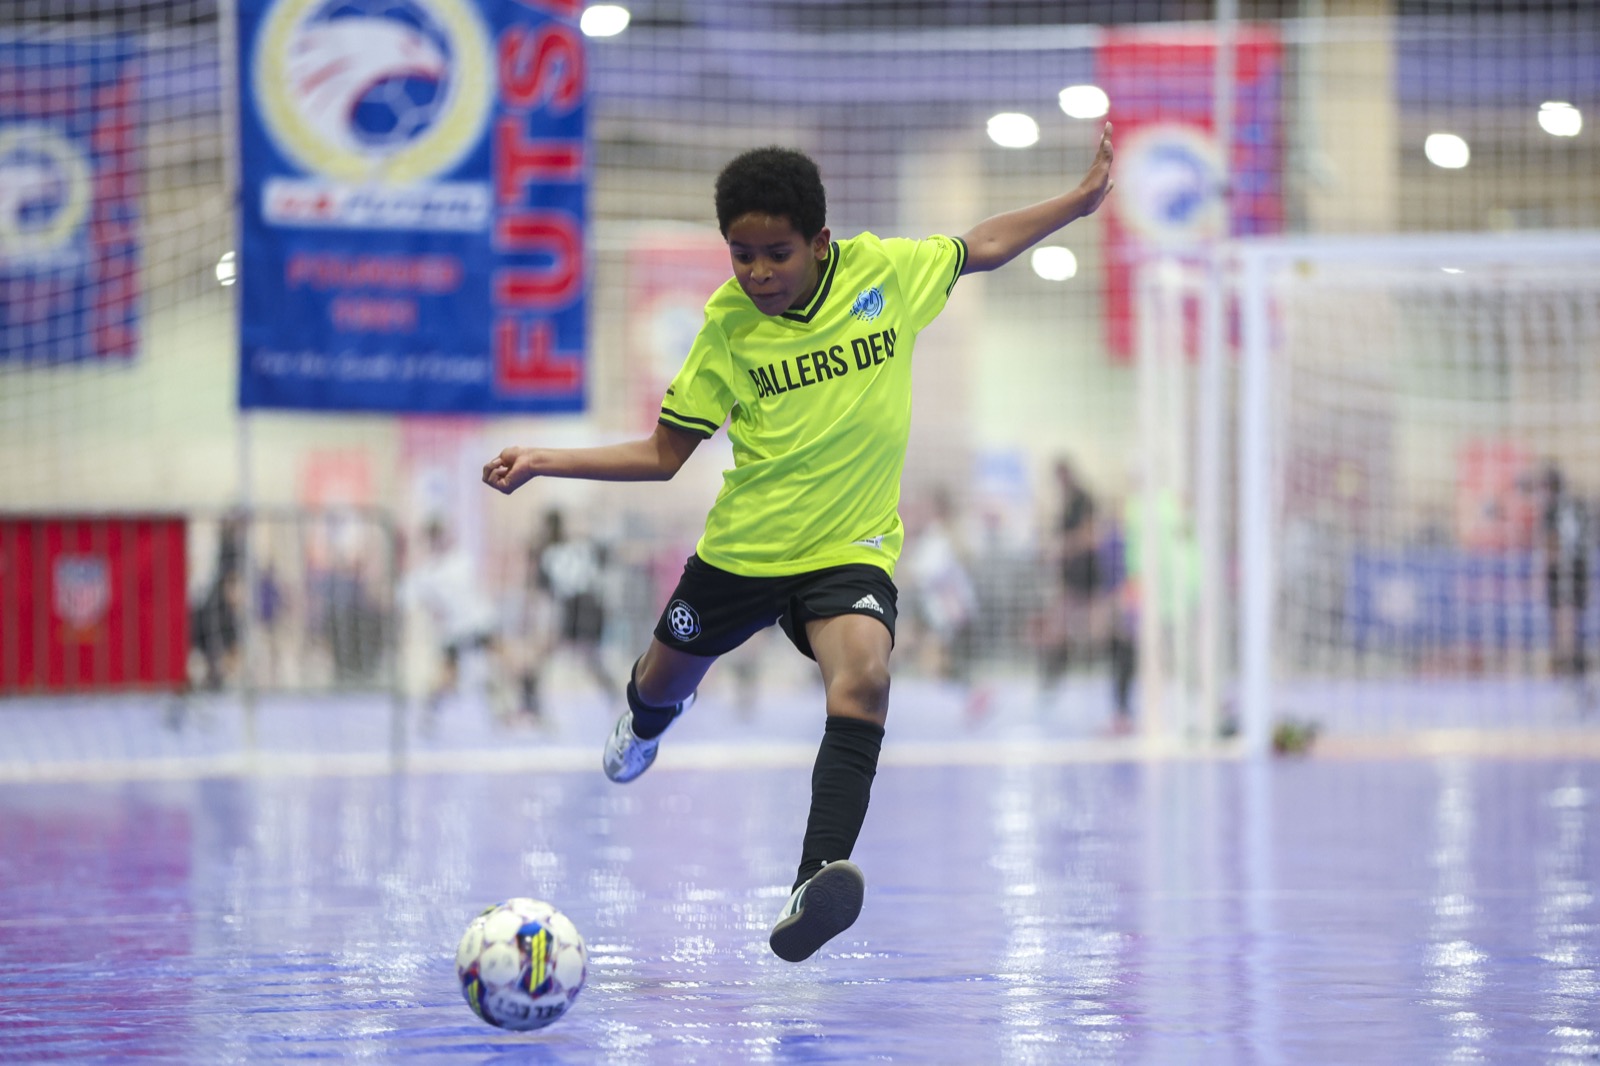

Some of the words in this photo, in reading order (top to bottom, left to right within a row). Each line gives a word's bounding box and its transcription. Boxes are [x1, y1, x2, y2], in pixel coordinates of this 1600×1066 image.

[496, 0, 585, 394] FUTS
[748, 345, 848, 399] BALLERS
[851, 327, 897, 371] DEN
